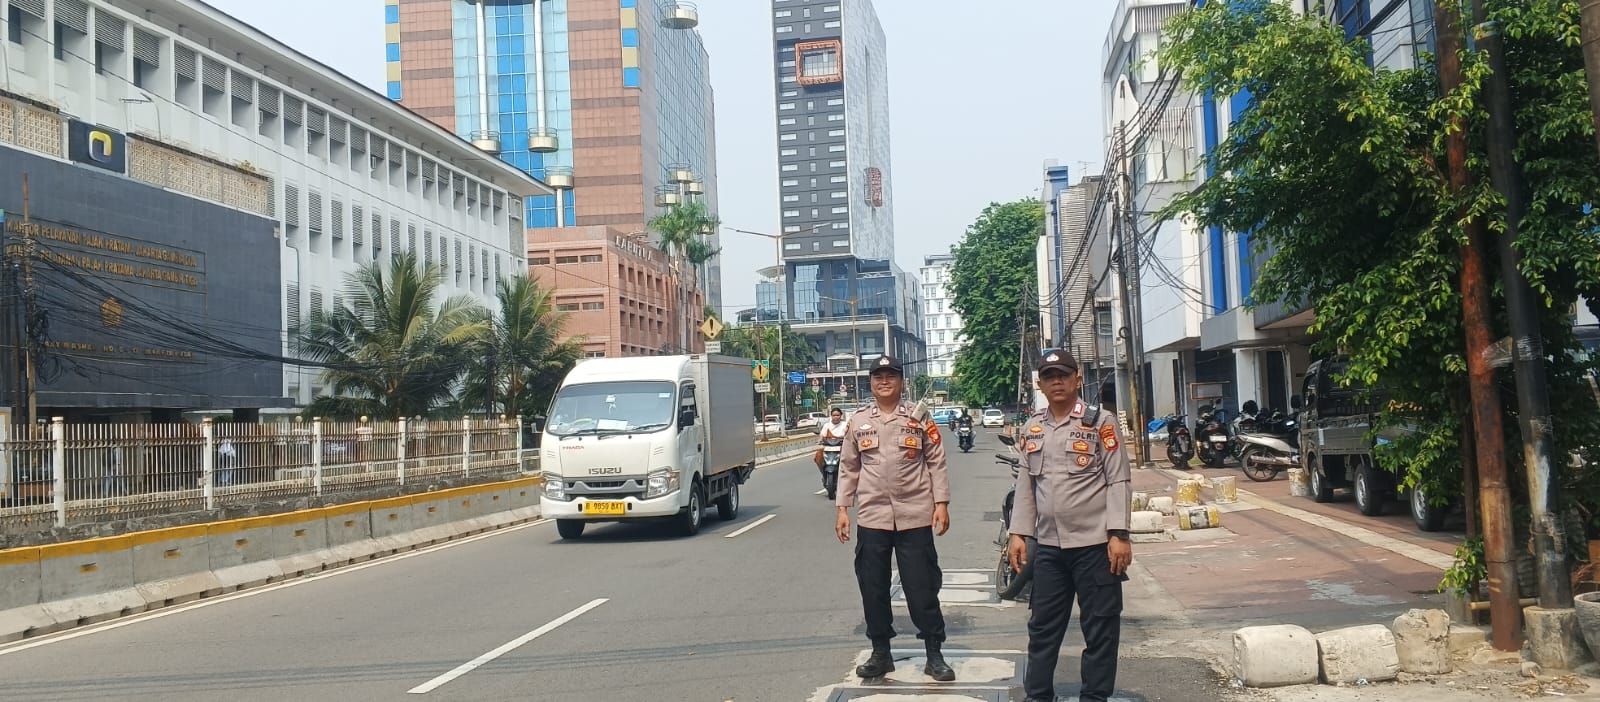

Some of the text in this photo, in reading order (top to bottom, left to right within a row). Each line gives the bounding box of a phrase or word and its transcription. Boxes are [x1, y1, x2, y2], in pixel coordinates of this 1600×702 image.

[901, 428, 921, 436] POLRI
[1069, 432, 1095, 440] POLRI
[588, 466, 622, 475] ISUZU
